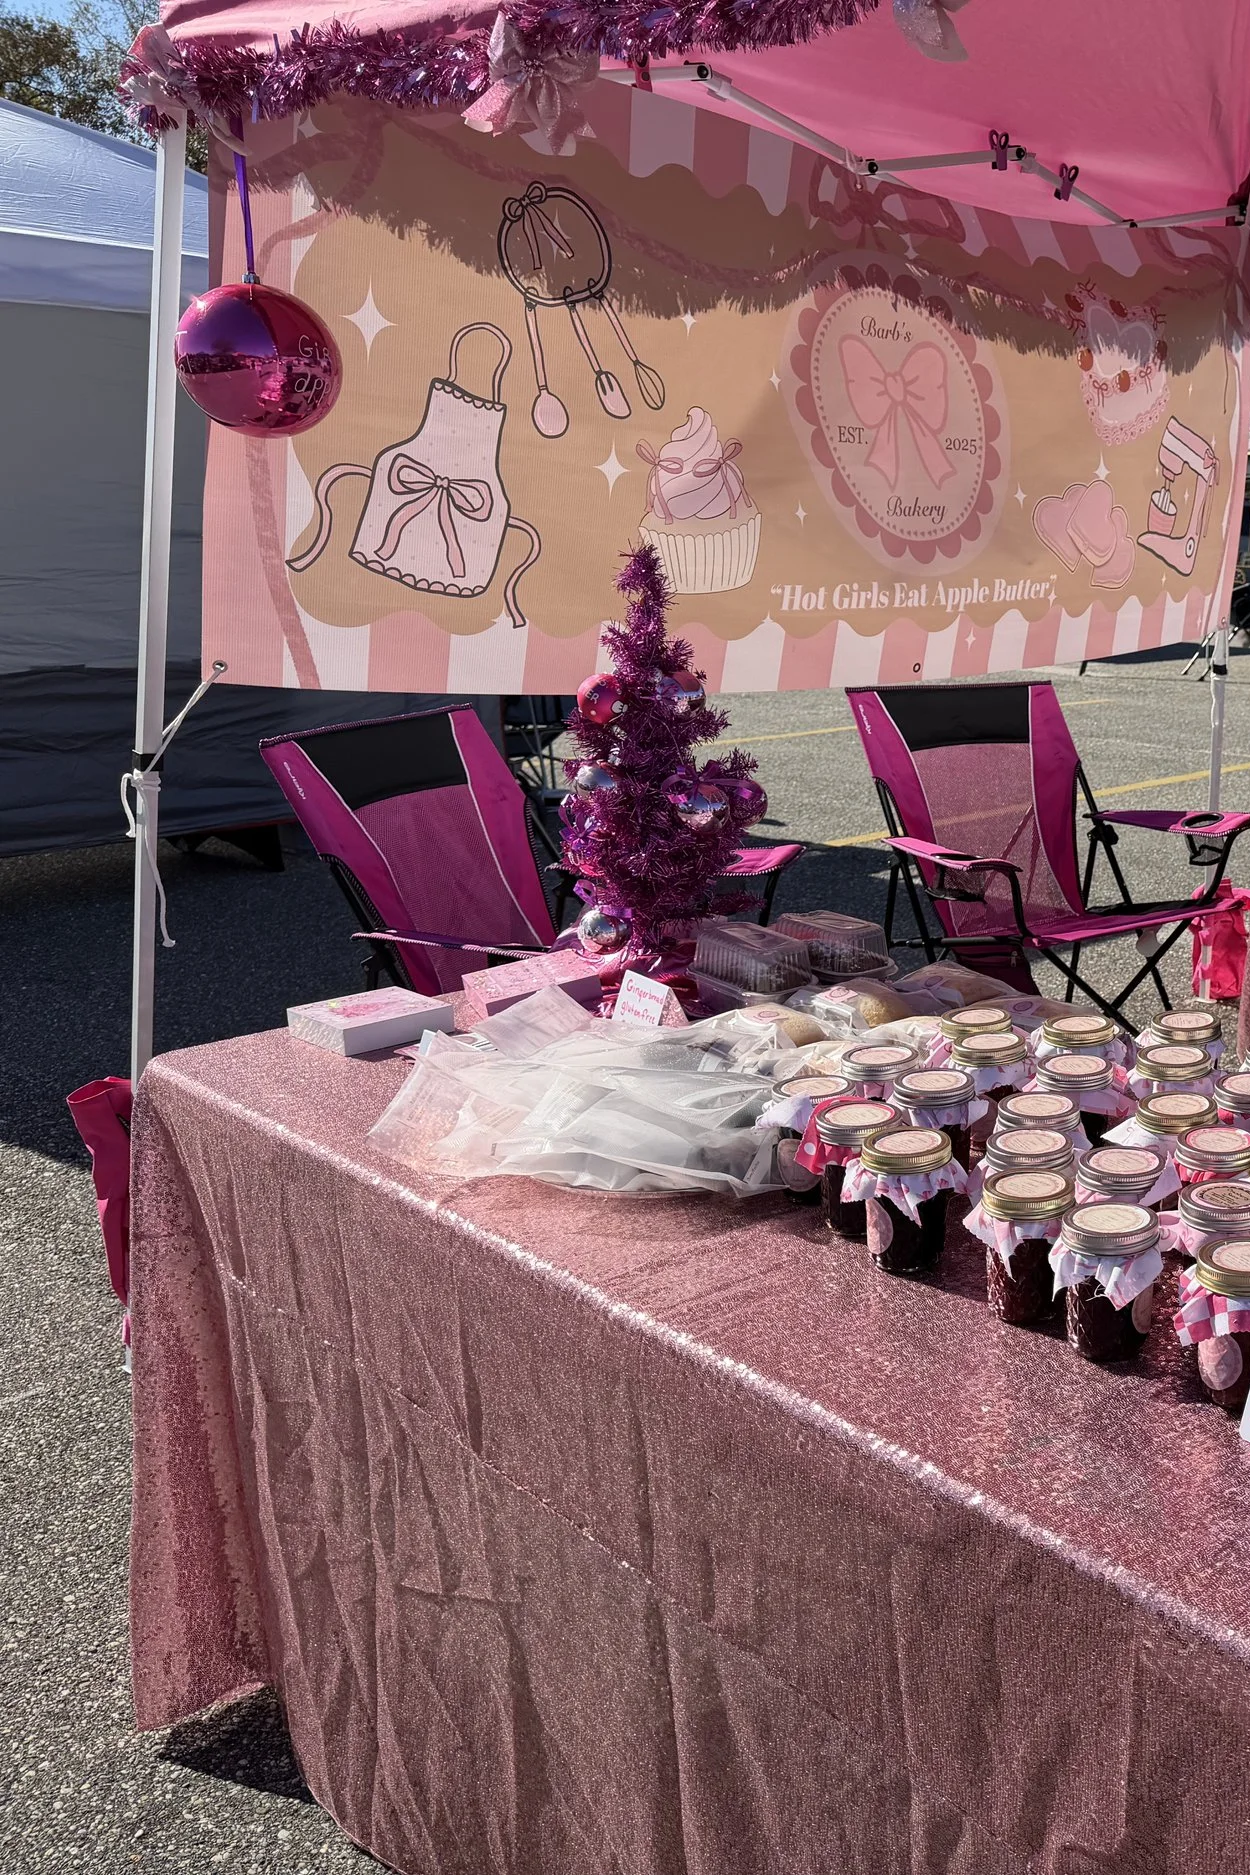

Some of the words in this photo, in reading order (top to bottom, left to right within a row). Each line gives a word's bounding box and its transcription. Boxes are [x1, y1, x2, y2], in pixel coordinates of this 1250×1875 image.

[860, 316, 912, 343] Barb's
[837, 425, 868, 444] EST.
[945, 438, 977, 455] 2025
[886, 495, 946, 524] Bakery
[832, 581, 890, 610] Girls
[893, 582, 928, 608] Eat
[932, 578, 989, 613] Apple
